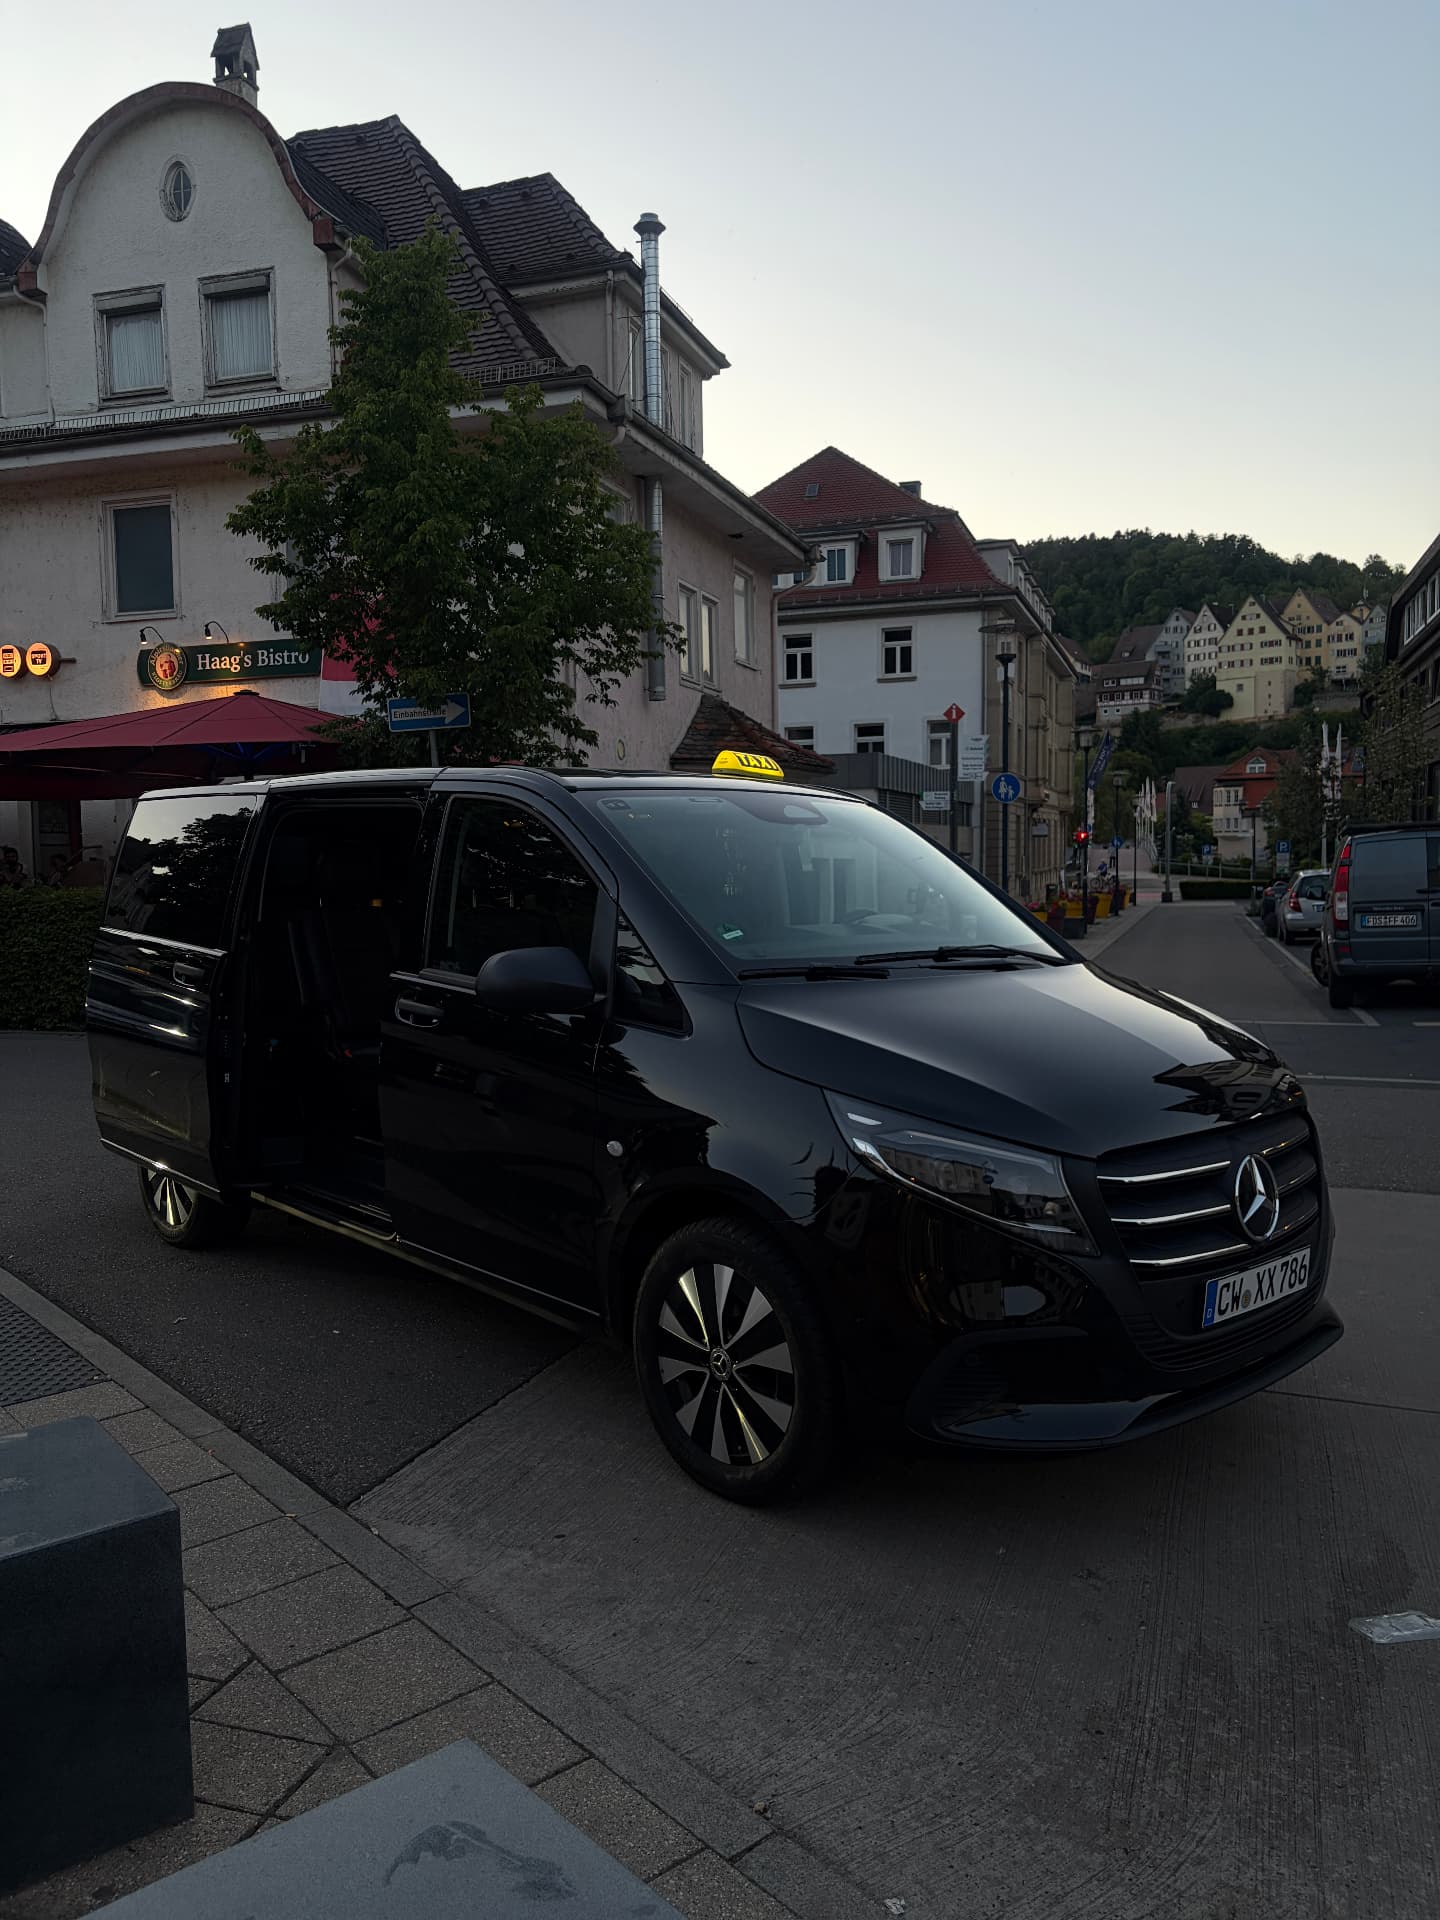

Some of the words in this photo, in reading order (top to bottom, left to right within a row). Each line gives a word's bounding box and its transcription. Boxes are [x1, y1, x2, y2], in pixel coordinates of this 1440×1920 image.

[196, 650, 252, 673] Haag's
[257, 648, 310, 667] Bistro
[393, 709, 447, 719] Einbahnstre
[734, 752, 779, 771] TAXI
[1217, 1277, 1244, 1316] CW
[1253, 1265, 1277, 1305] XX
[1279, 1254, 1307, 1294] 786
